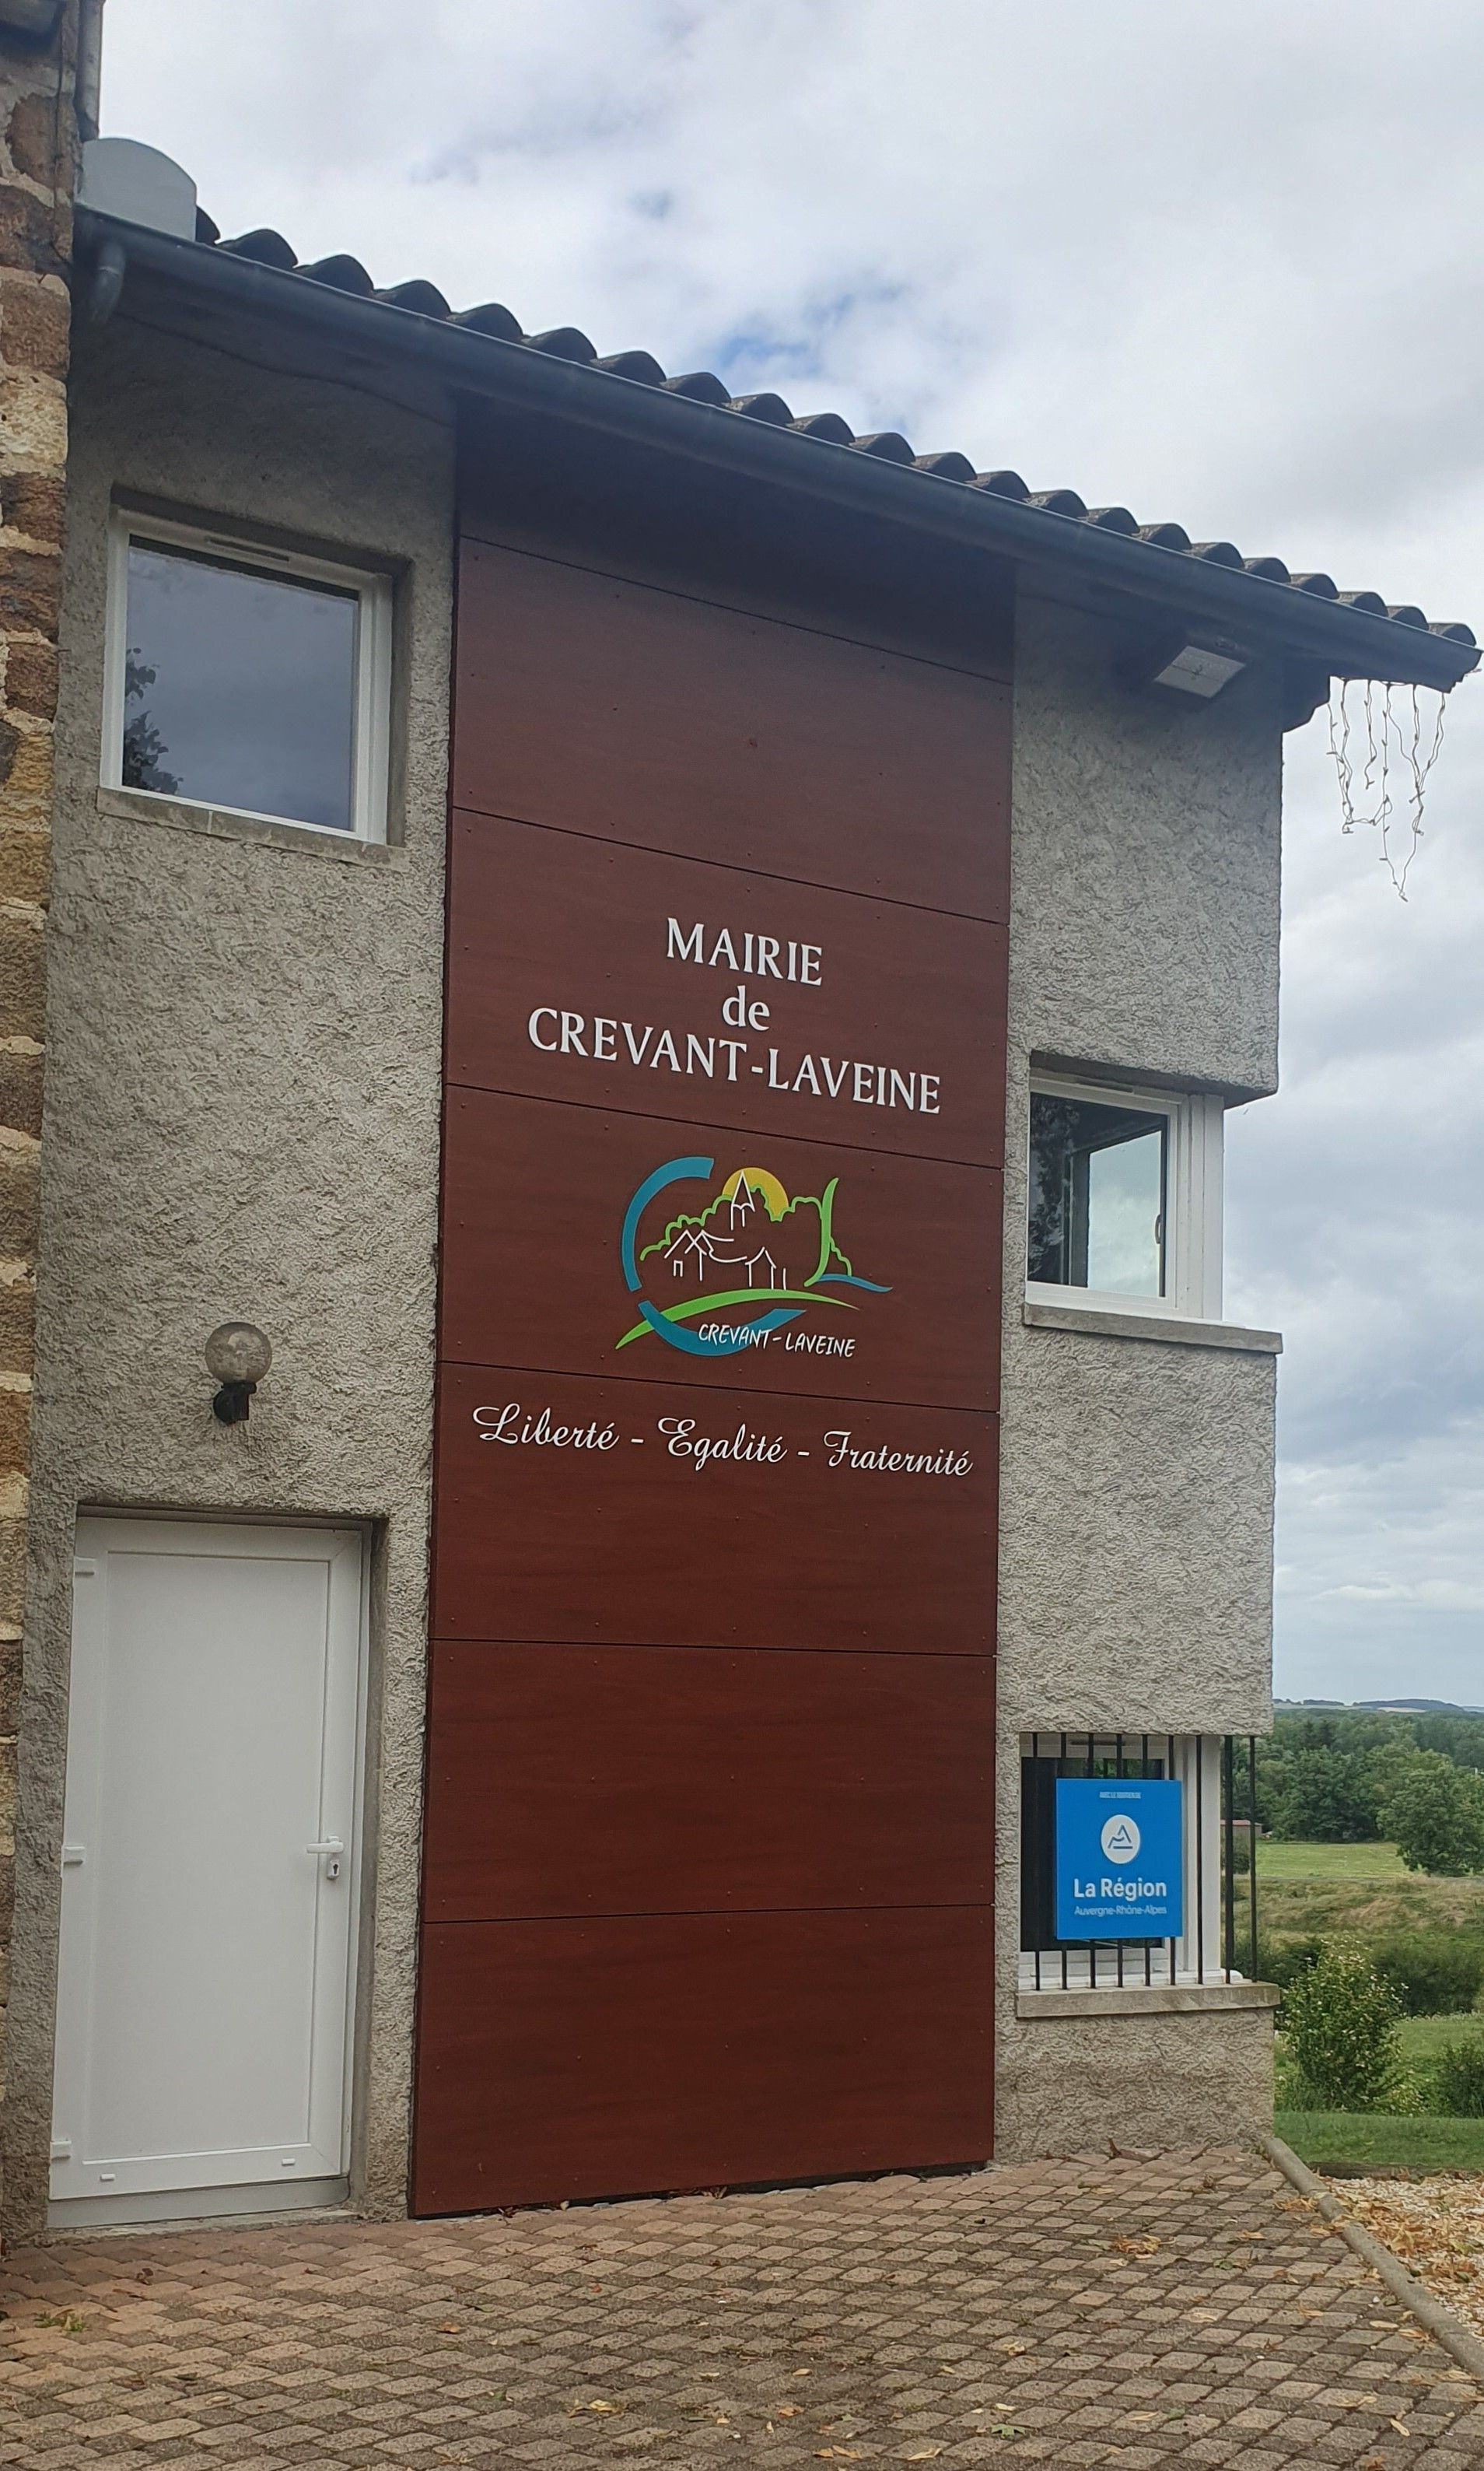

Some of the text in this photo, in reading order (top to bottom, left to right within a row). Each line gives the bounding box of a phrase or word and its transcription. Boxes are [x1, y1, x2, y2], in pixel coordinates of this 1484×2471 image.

[667, 917, 823, 986] MAIRIE
[722, 984, 771, 1032] de
[527, 1007, 940, 1115] CREVANT-LAVEINE
[698, 1323, 856, 1358] CREVANT-LAVEINE
[472, 1402, 620, 1452] Liberté
[657, 1417, 788, 1472] Egalité
[823, 1429, 975, 1477] Fraternité
[1073, 1877, 1167, 1901] La Région
[1074, 1905, 1167, 1917] Auvergne-Rhône-Alpes
